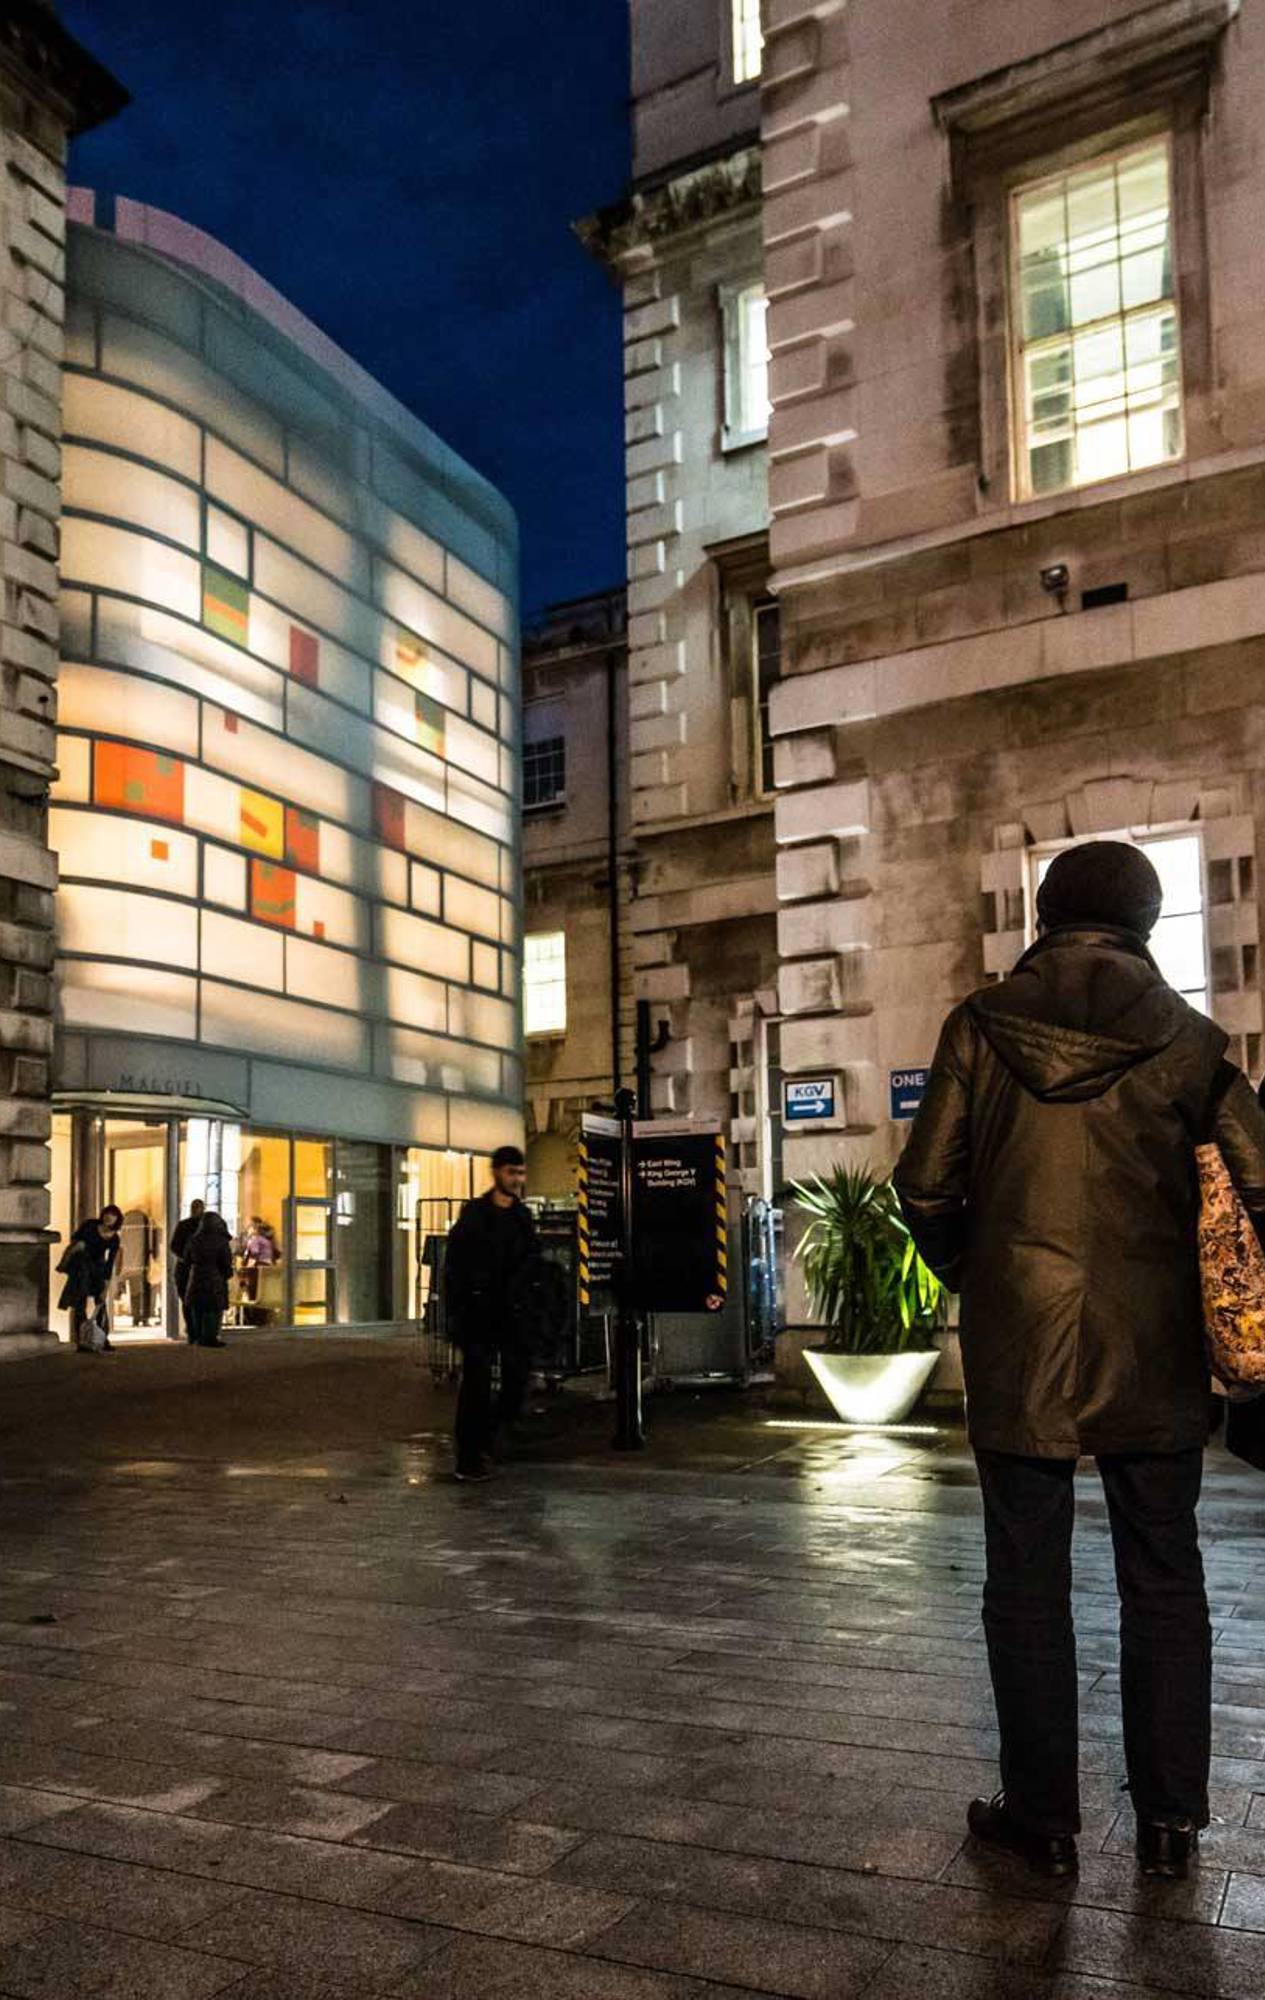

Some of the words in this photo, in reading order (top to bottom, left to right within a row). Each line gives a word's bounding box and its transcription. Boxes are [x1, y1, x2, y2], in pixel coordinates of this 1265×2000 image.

[892, 1073, 926, 1088] ONE
[794, 1085, 825, 1097] KGV
[647, 1170, 663, 1178] King
[664, 1169, 690, 1178] George
